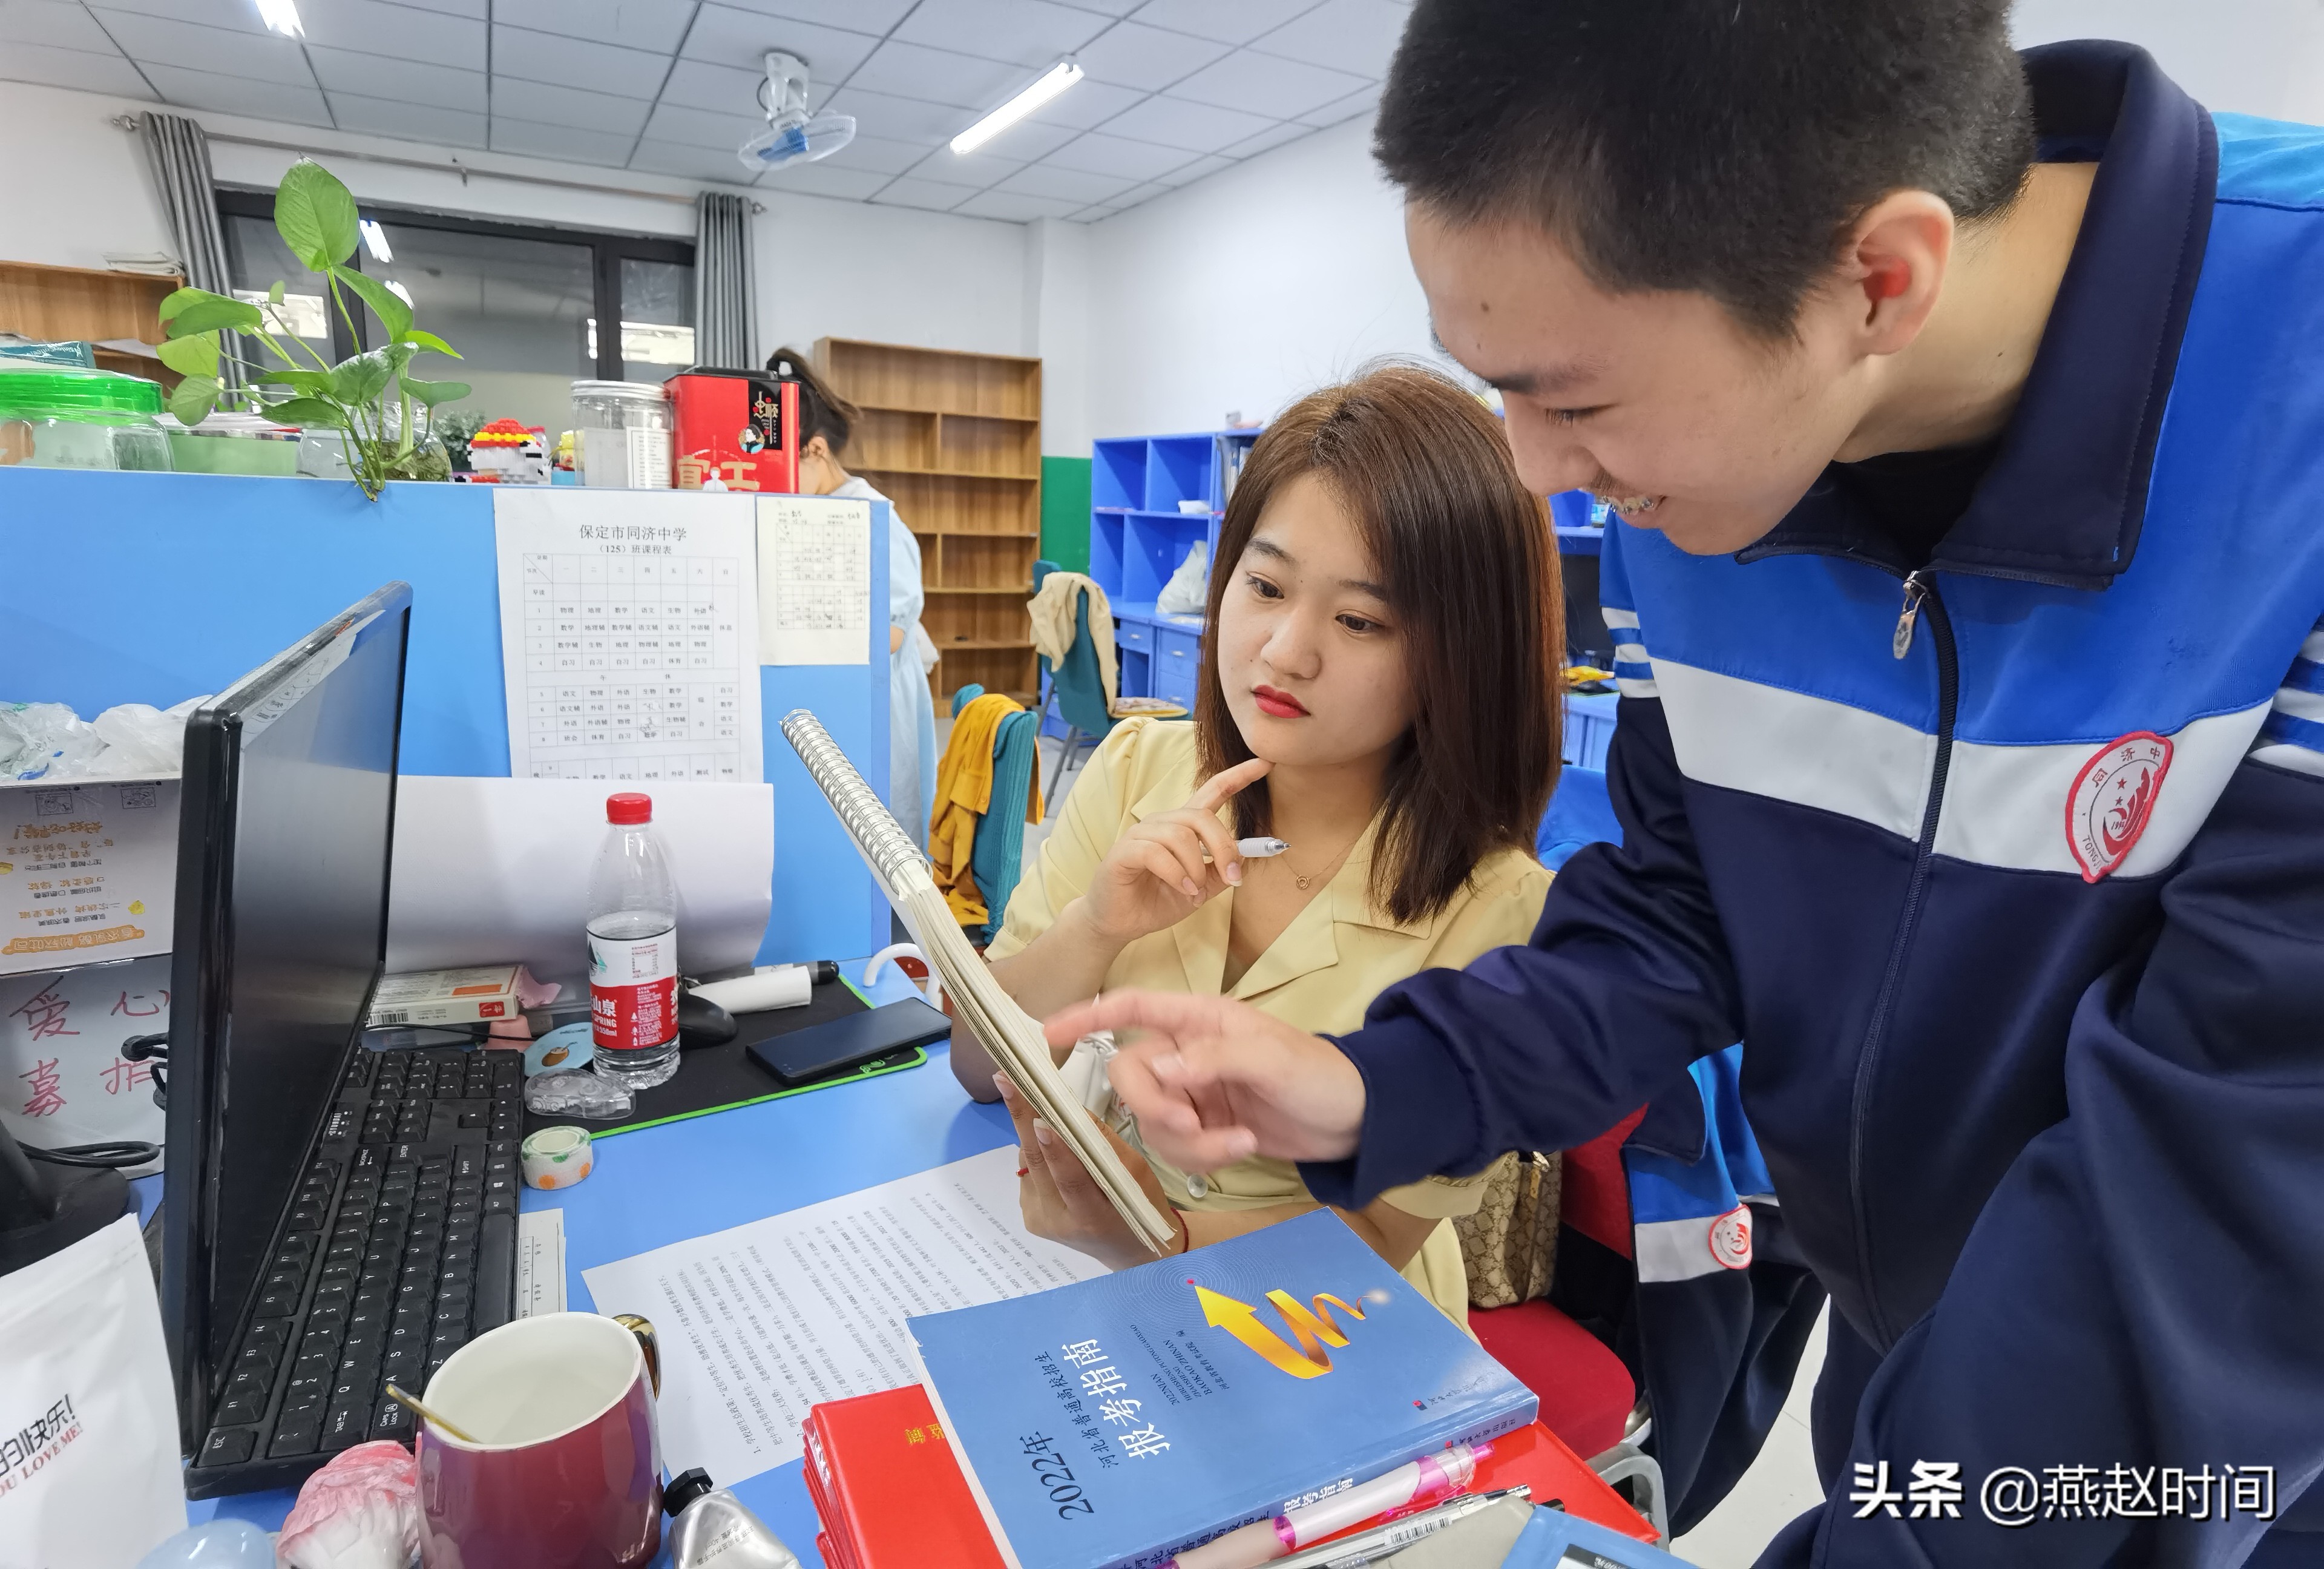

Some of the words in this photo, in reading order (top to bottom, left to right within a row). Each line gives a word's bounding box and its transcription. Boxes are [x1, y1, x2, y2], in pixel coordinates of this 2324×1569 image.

[580, 525, 686, 541] 保定市同济中学
[591, 995, 617, 1018] 山泉
[1163, 1340, 1188, 1365] ZHINAN
[1151, 1374, 1180, 1405] 2022NIAN
[1184, 1366, 1212, 1395] BAOKAO
[1034, 1350, 1120, 1469] 河北省普通高校招生
[1063, 1338, 1172, 1461] 报考指南
[21, 1441, 61, 1479] LOVE
[1020, 1430, 1095, 1521] 2022年
[1283, 1478, 1353, 1513] 报考指南
